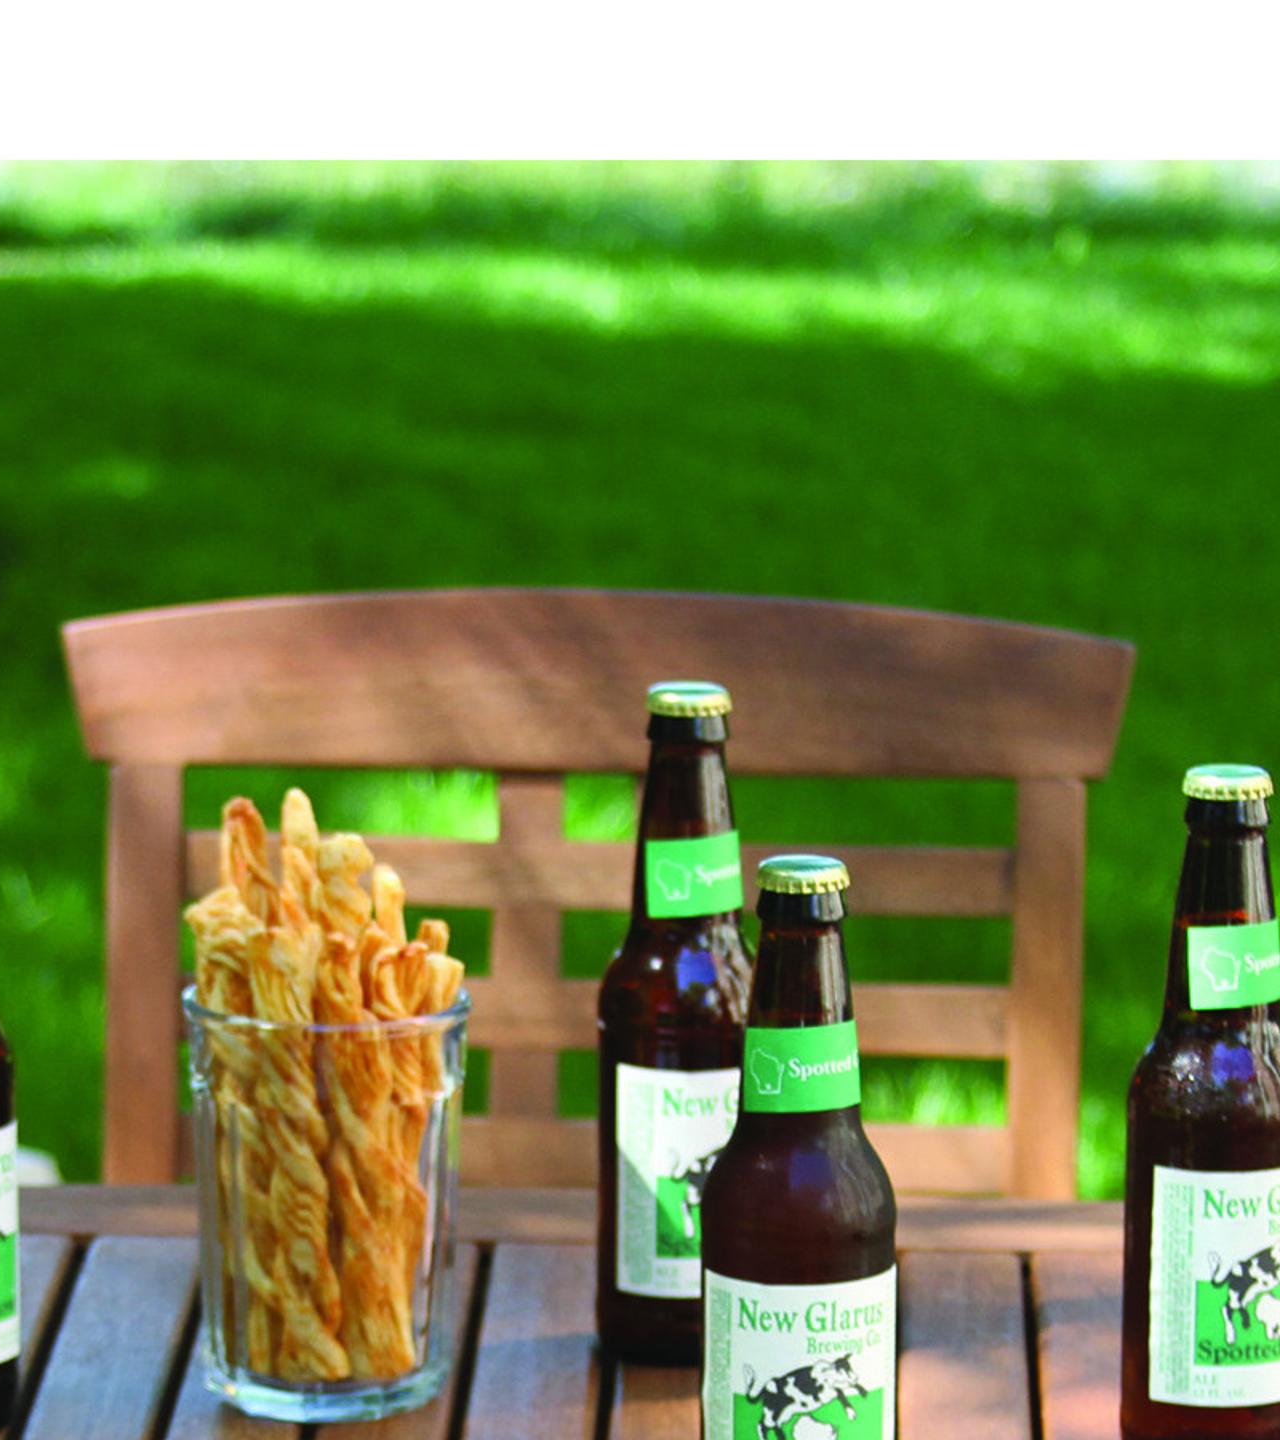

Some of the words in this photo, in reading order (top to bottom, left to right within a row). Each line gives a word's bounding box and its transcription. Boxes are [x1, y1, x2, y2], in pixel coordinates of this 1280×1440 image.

[661, 1087, 718, 1118] New
[1203, 1189, 1262, 1218] New
[738, 1297, 799, 1333] New
[805, 1300, 884, 1333] Glarus
